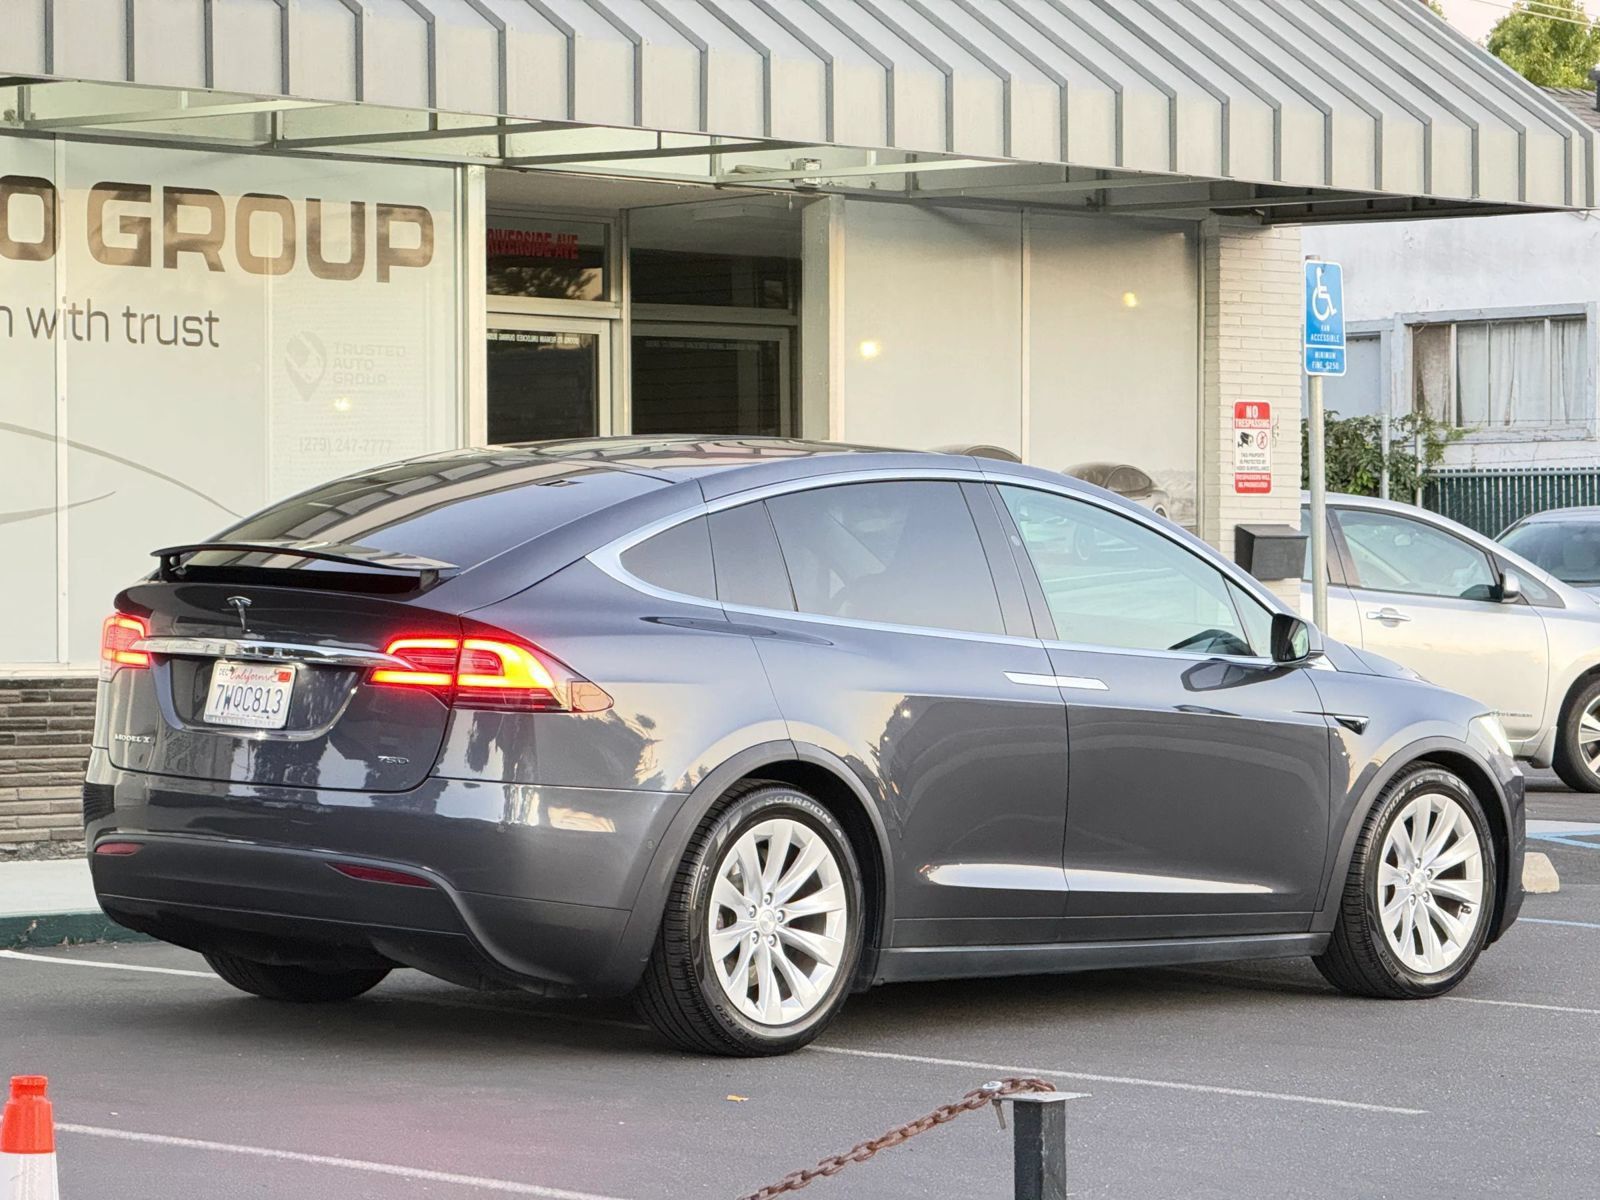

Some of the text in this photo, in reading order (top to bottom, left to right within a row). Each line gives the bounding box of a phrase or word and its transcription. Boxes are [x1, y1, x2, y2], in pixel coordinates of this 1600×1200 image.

[87, 180, 435, 283] GROUP
[26, 296, 110, 342] with
[122, 304, 220, 348] trust
[1311, 333, 1340, 343] ACCESSIBLE
[334, 342, 406, 357] TRUSTED
[333, 358, 375, 371] AUTO
[333, 372, 387, 386] GROUP
[1246, 405, 1259, 418] NO
[230, 667, 274, 684] California
[215, 683, 284, 714] 7WQC813
[115, 733, 151, 743] MODEL X
[765, 795, 832, 824] SCORPION
